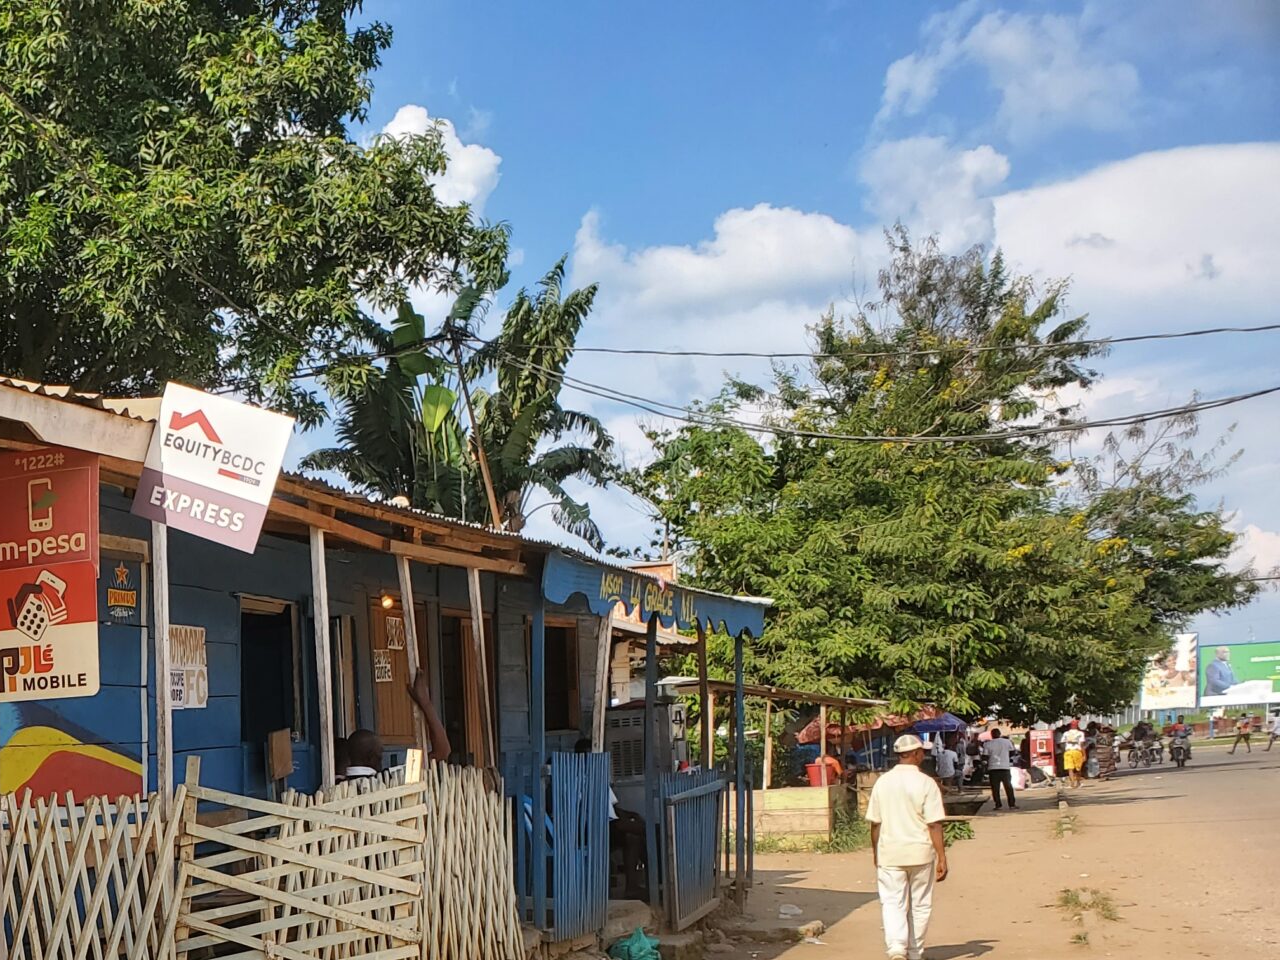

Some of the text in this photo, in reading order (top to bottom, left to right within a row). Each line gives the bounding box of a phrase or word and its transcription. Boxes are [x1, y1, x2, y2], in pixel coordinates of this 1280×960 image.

[149, 485, 246, 533] EXPRESS
[109, 590, 136, 606] PRIMUS
[23, 672, 87, 692] MOBILE
